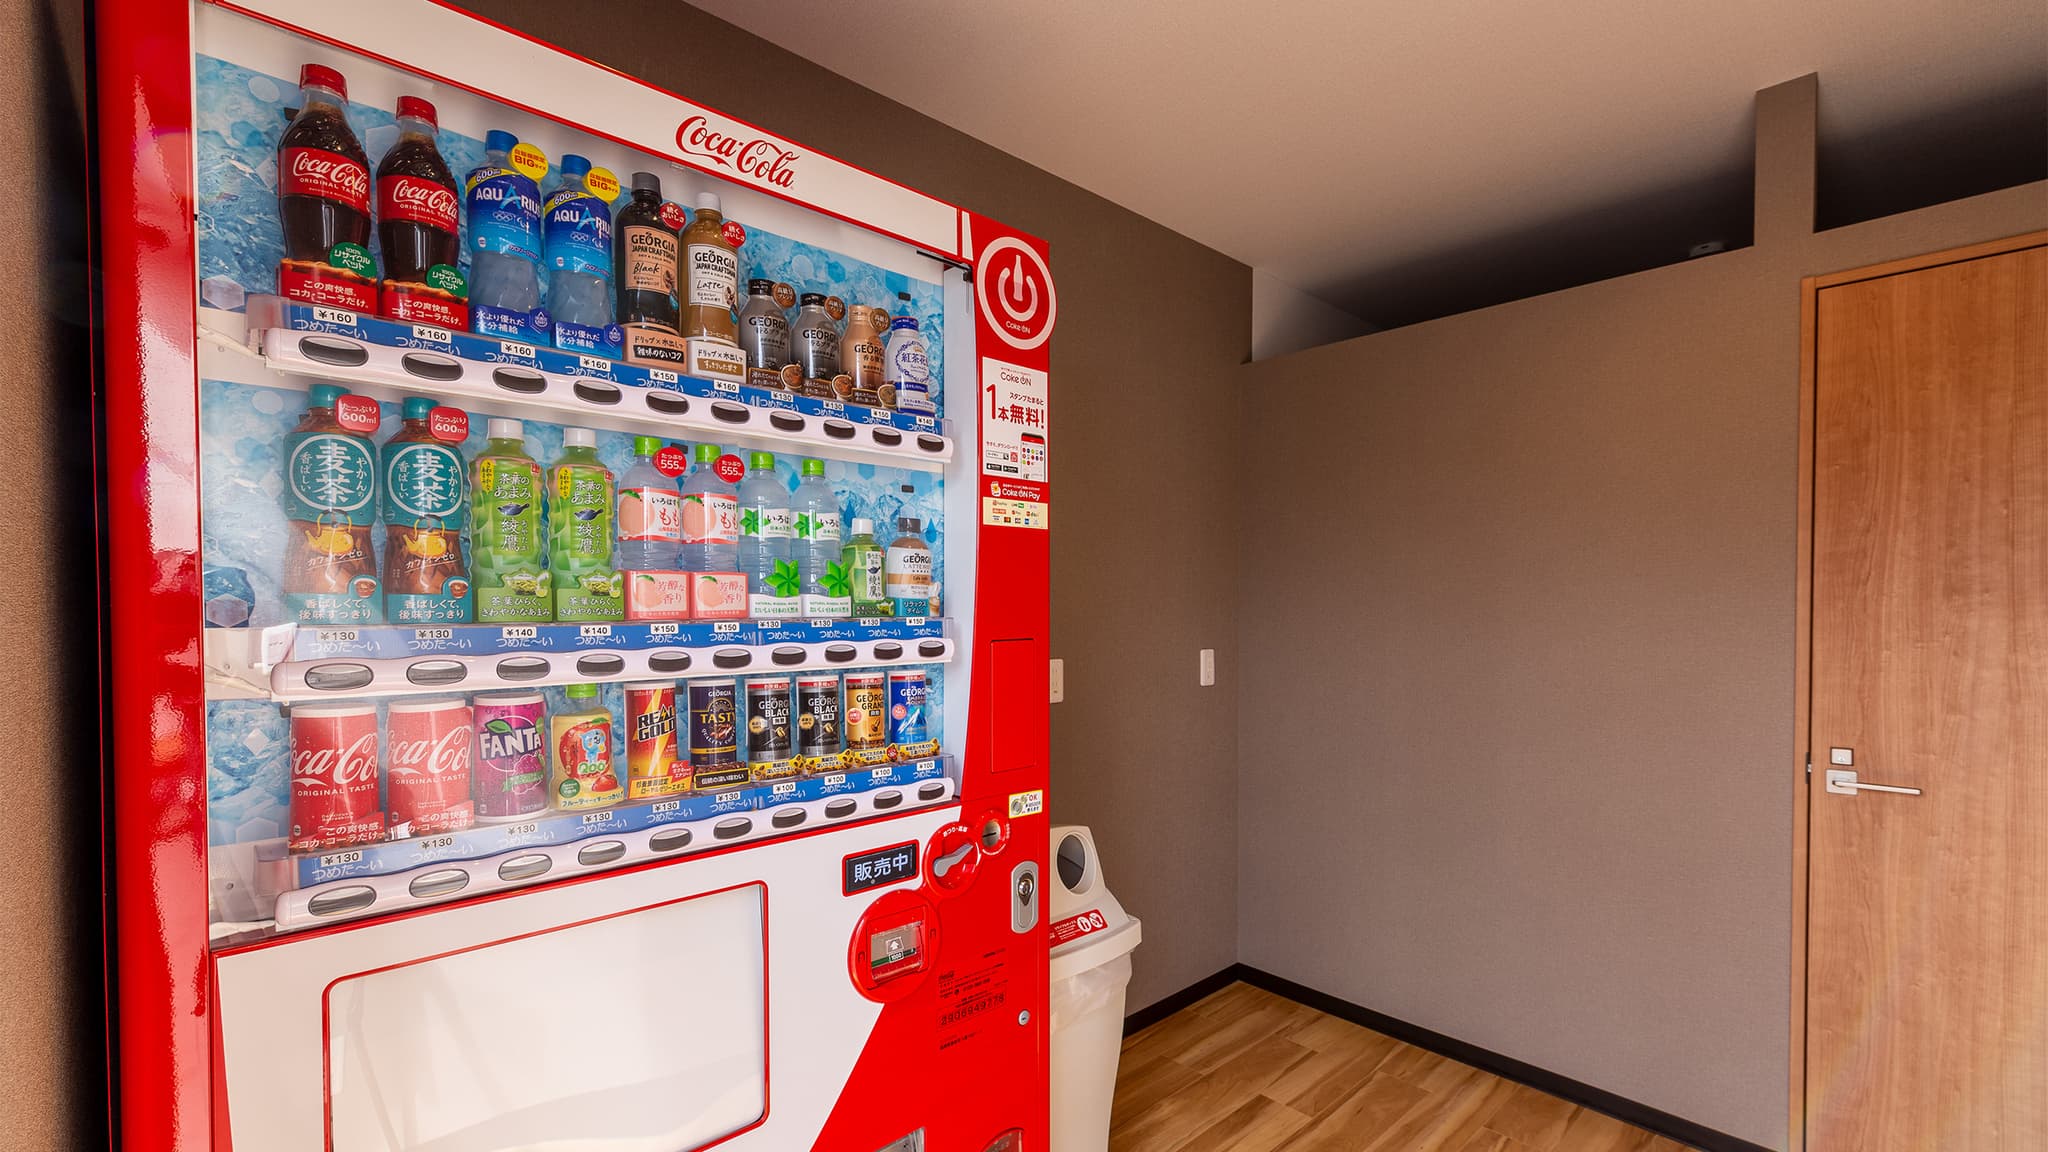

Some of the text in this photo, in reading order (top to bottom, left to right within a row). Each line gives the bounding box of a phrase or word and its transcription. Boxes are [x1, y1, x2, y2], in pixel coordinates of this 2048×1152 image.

[675, 116, 800, 188] Coca-Cola
[292, 151, 368, 193] Coca-Cola
[299, 177, 339, 189] ORIGINAL
[393, 179, 458, 218] Coca-Cola
[400, 204, 435, 215] ORIGINAL
[631, 232, 675, 253] GEORGIA
[694, 250, 735, 271] GEORGIA
[633, 262, 660, 274] Black
[697, 279, 724, 289] Latte
[318, 310, 352, 323] ¥160
[417, 328, 447, 342] ¥160
[505, 344, 532, 356] ¥160
[583, 358, 607, 370] ¥160
[653, 372, 675, 381] ¥150
[1000, 371, 1019, 383] Coke
[1020, 375, 1032, 386] ON
[717, 382, 737, 392] ¥160
[341, 402, 377, 415] たっぷり
[341, 411, 377, 425] 600ml
[434, 413, 467, 425] たっぷり
[434, 422, 467, 434] 600ml
[300, 451, 313, 492] 香ばしい
[313, 441, 355, 504] 麦茶
[397, 461, 411, 499] 香ばしい
[410, 451, 448, 511] 麦茶
[494, 487, 532, 499] あまみ
[571, 493, 606, 505] あまみ
[1002, 488, 1041, 501] Coke ON Pay
[501, 519, 519, 552] 綾鷹
[577, 524, 594, 554] 綾鷹
[299, 609, 371, 621] 後味すっきり
[399, 609, 465, 620] 後味すっきり
[481, 607, 550, 617] さわやかなあまみ
[559, 607, 623, 616] さわやかなあまみ
[418, 630, 450, 639] ¥130
[507, 628, 533, 637] ¥140
[584, 626, 608, 635] ¥140
[654, 625, 676, 633] ¥150
[320, 631, 356, 641] ¥130
[480, 727, 542, 760] FANTA
[387, 726, 473, 774] oca-Col
[290, 733, 378, 784] oca-Col
[396, 773, 466, 785] ORIGINAL TASTE
[297, 782, 375, 797] ORIGINAL TASTE
[655, 802, 678, 811] ¥130
[585, 812, 610, 822] ¥130
[507, 824, 536, 834] ¥130
[422, 838, 453, 849] ¥130
[324, 853, 360, 865] ¥130
[854, 853, 909, 883] 販売中
